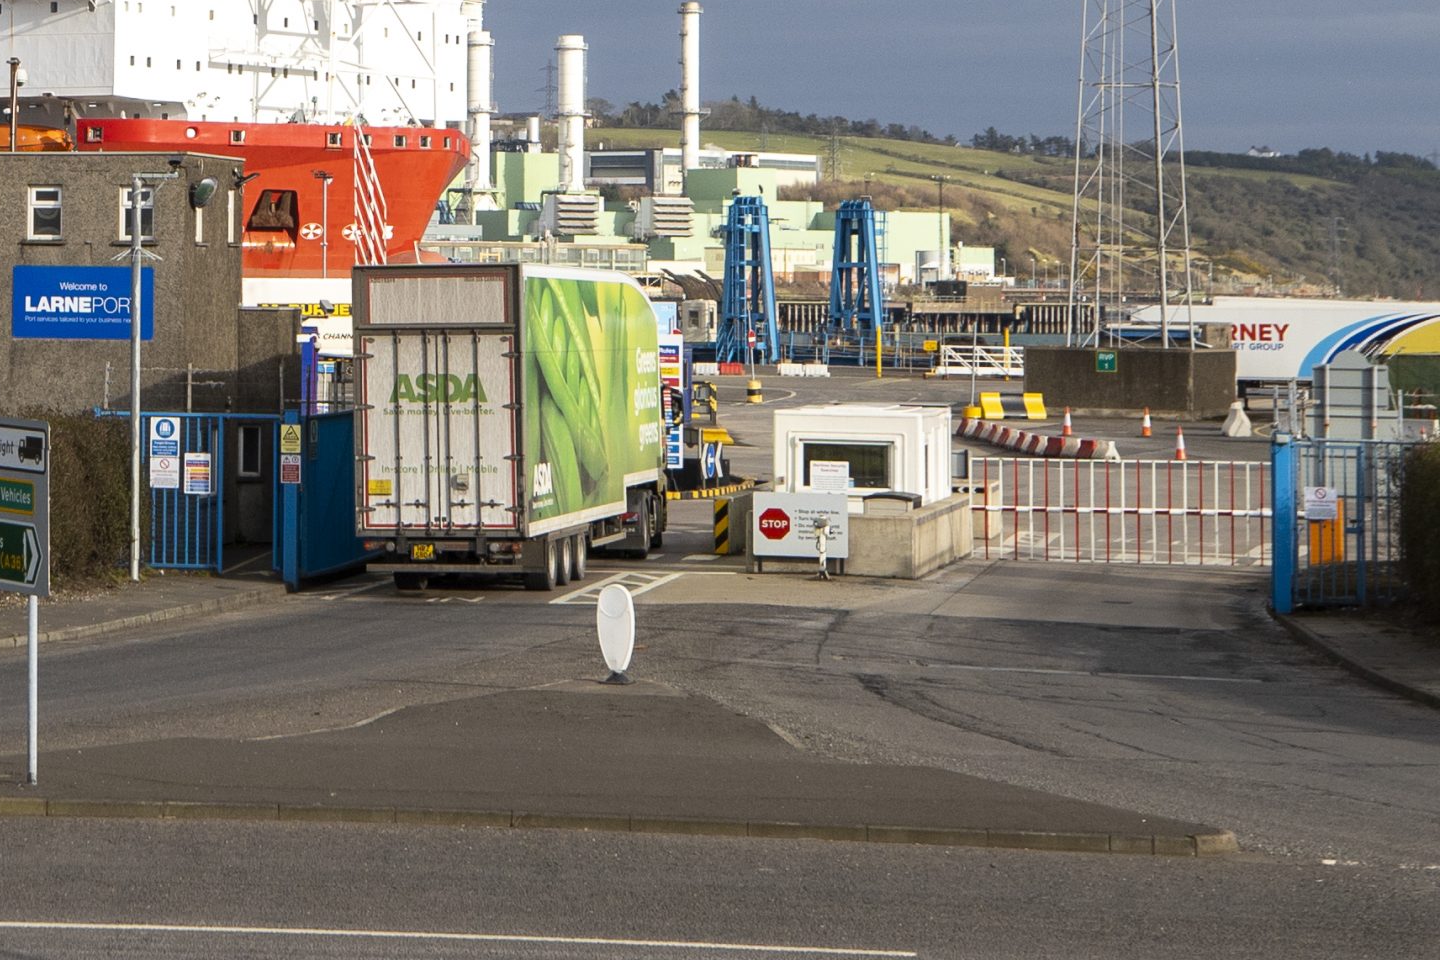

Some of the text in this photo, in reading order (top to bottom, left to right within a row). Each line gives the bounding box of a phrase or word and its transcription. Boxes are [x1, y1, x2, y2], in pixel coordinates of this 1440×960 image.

[59, 282, 108, 292] Welcome to
[24, 296, 132, 314] LARNEPOR
[24, 315, 36, 323] Port
[98, 316, 122, 324] business
[1249, 343, 1284, 351] GROUP
[635, 346, 657, 374] Greens
[389, 373, 488, 403] ASDA
[634, 381, 658, 417] glorious
[407, 409, 437, 417] moey
[463, 407, 495, 416] beter.
[639, 422, 659, 452] greens
[533, 462, 553, 497] ASDA
[0, 486, 31, 505] Vehicles
[761, 519, 788, 529] STOP
